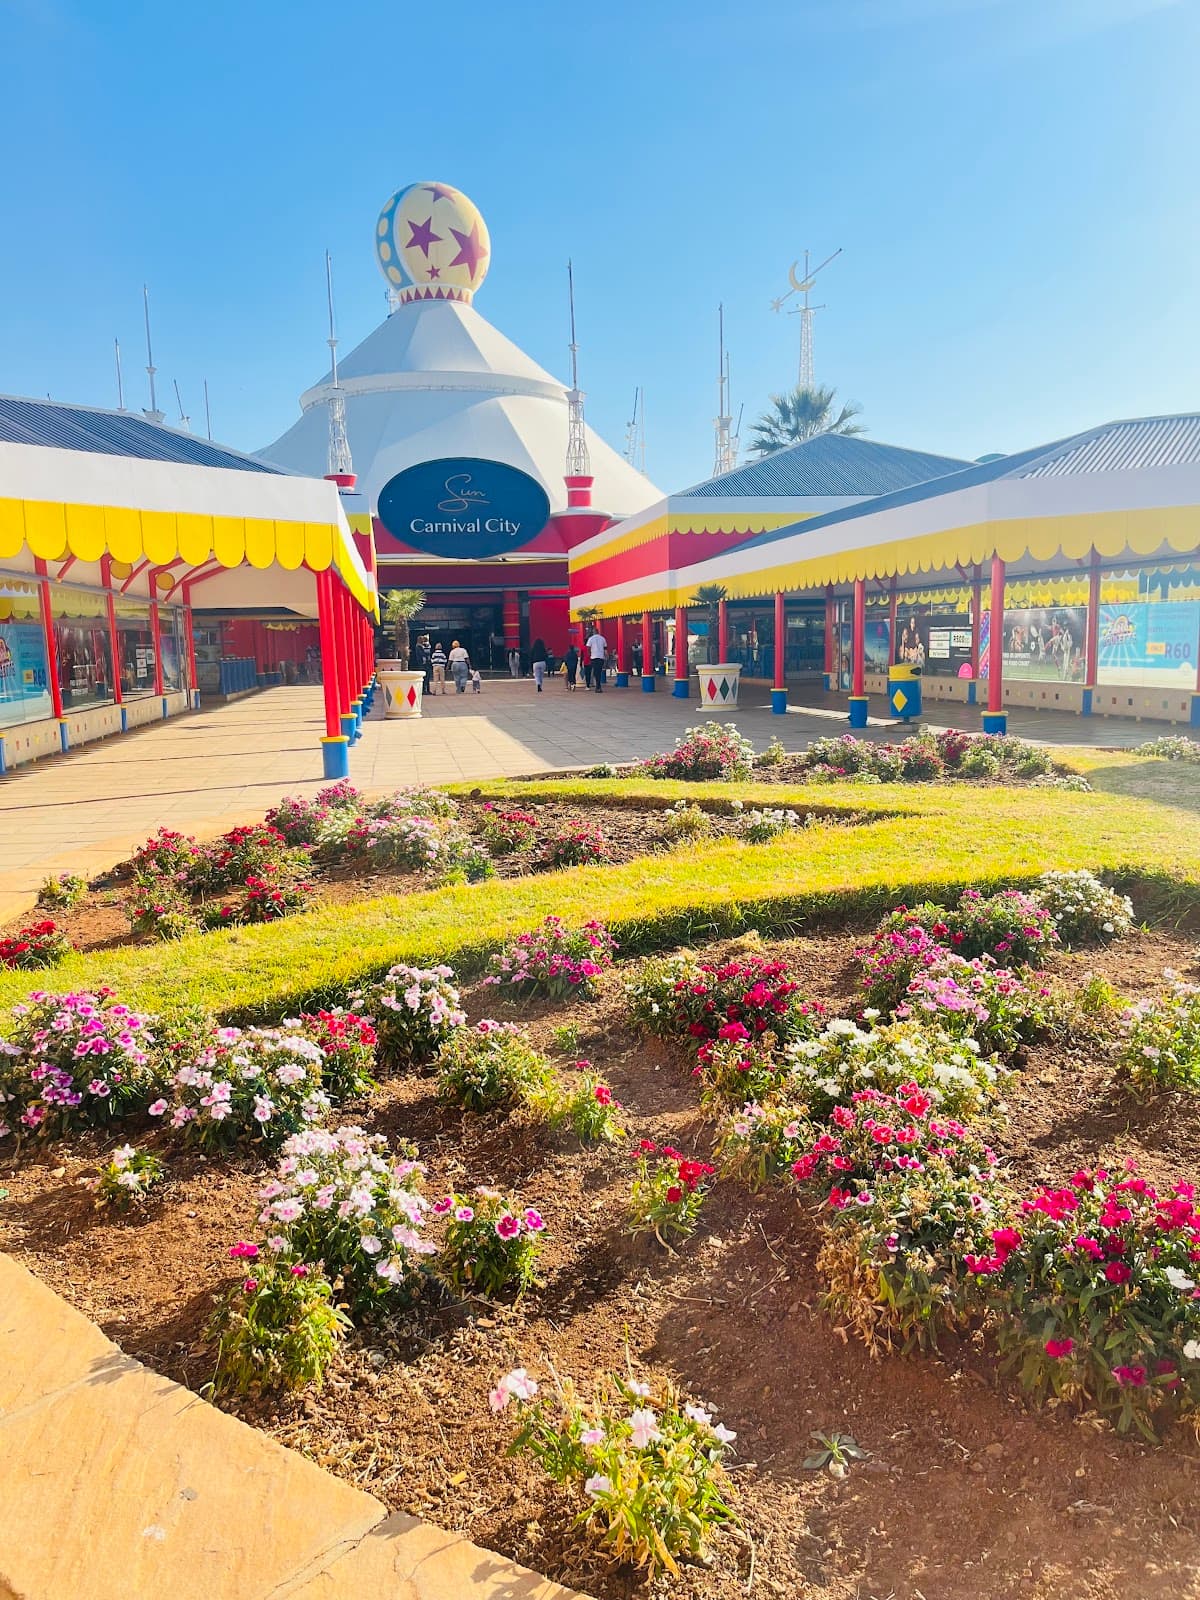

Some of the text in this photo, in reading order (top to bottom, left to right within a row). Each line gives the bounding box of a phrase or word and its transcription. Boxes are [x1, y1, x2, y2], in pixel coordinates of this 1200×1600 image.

[437, 473, 491, 512] Sun
[410, 518, 521, 536] Carnival City
[1164, 641, 1191, 659] R60
